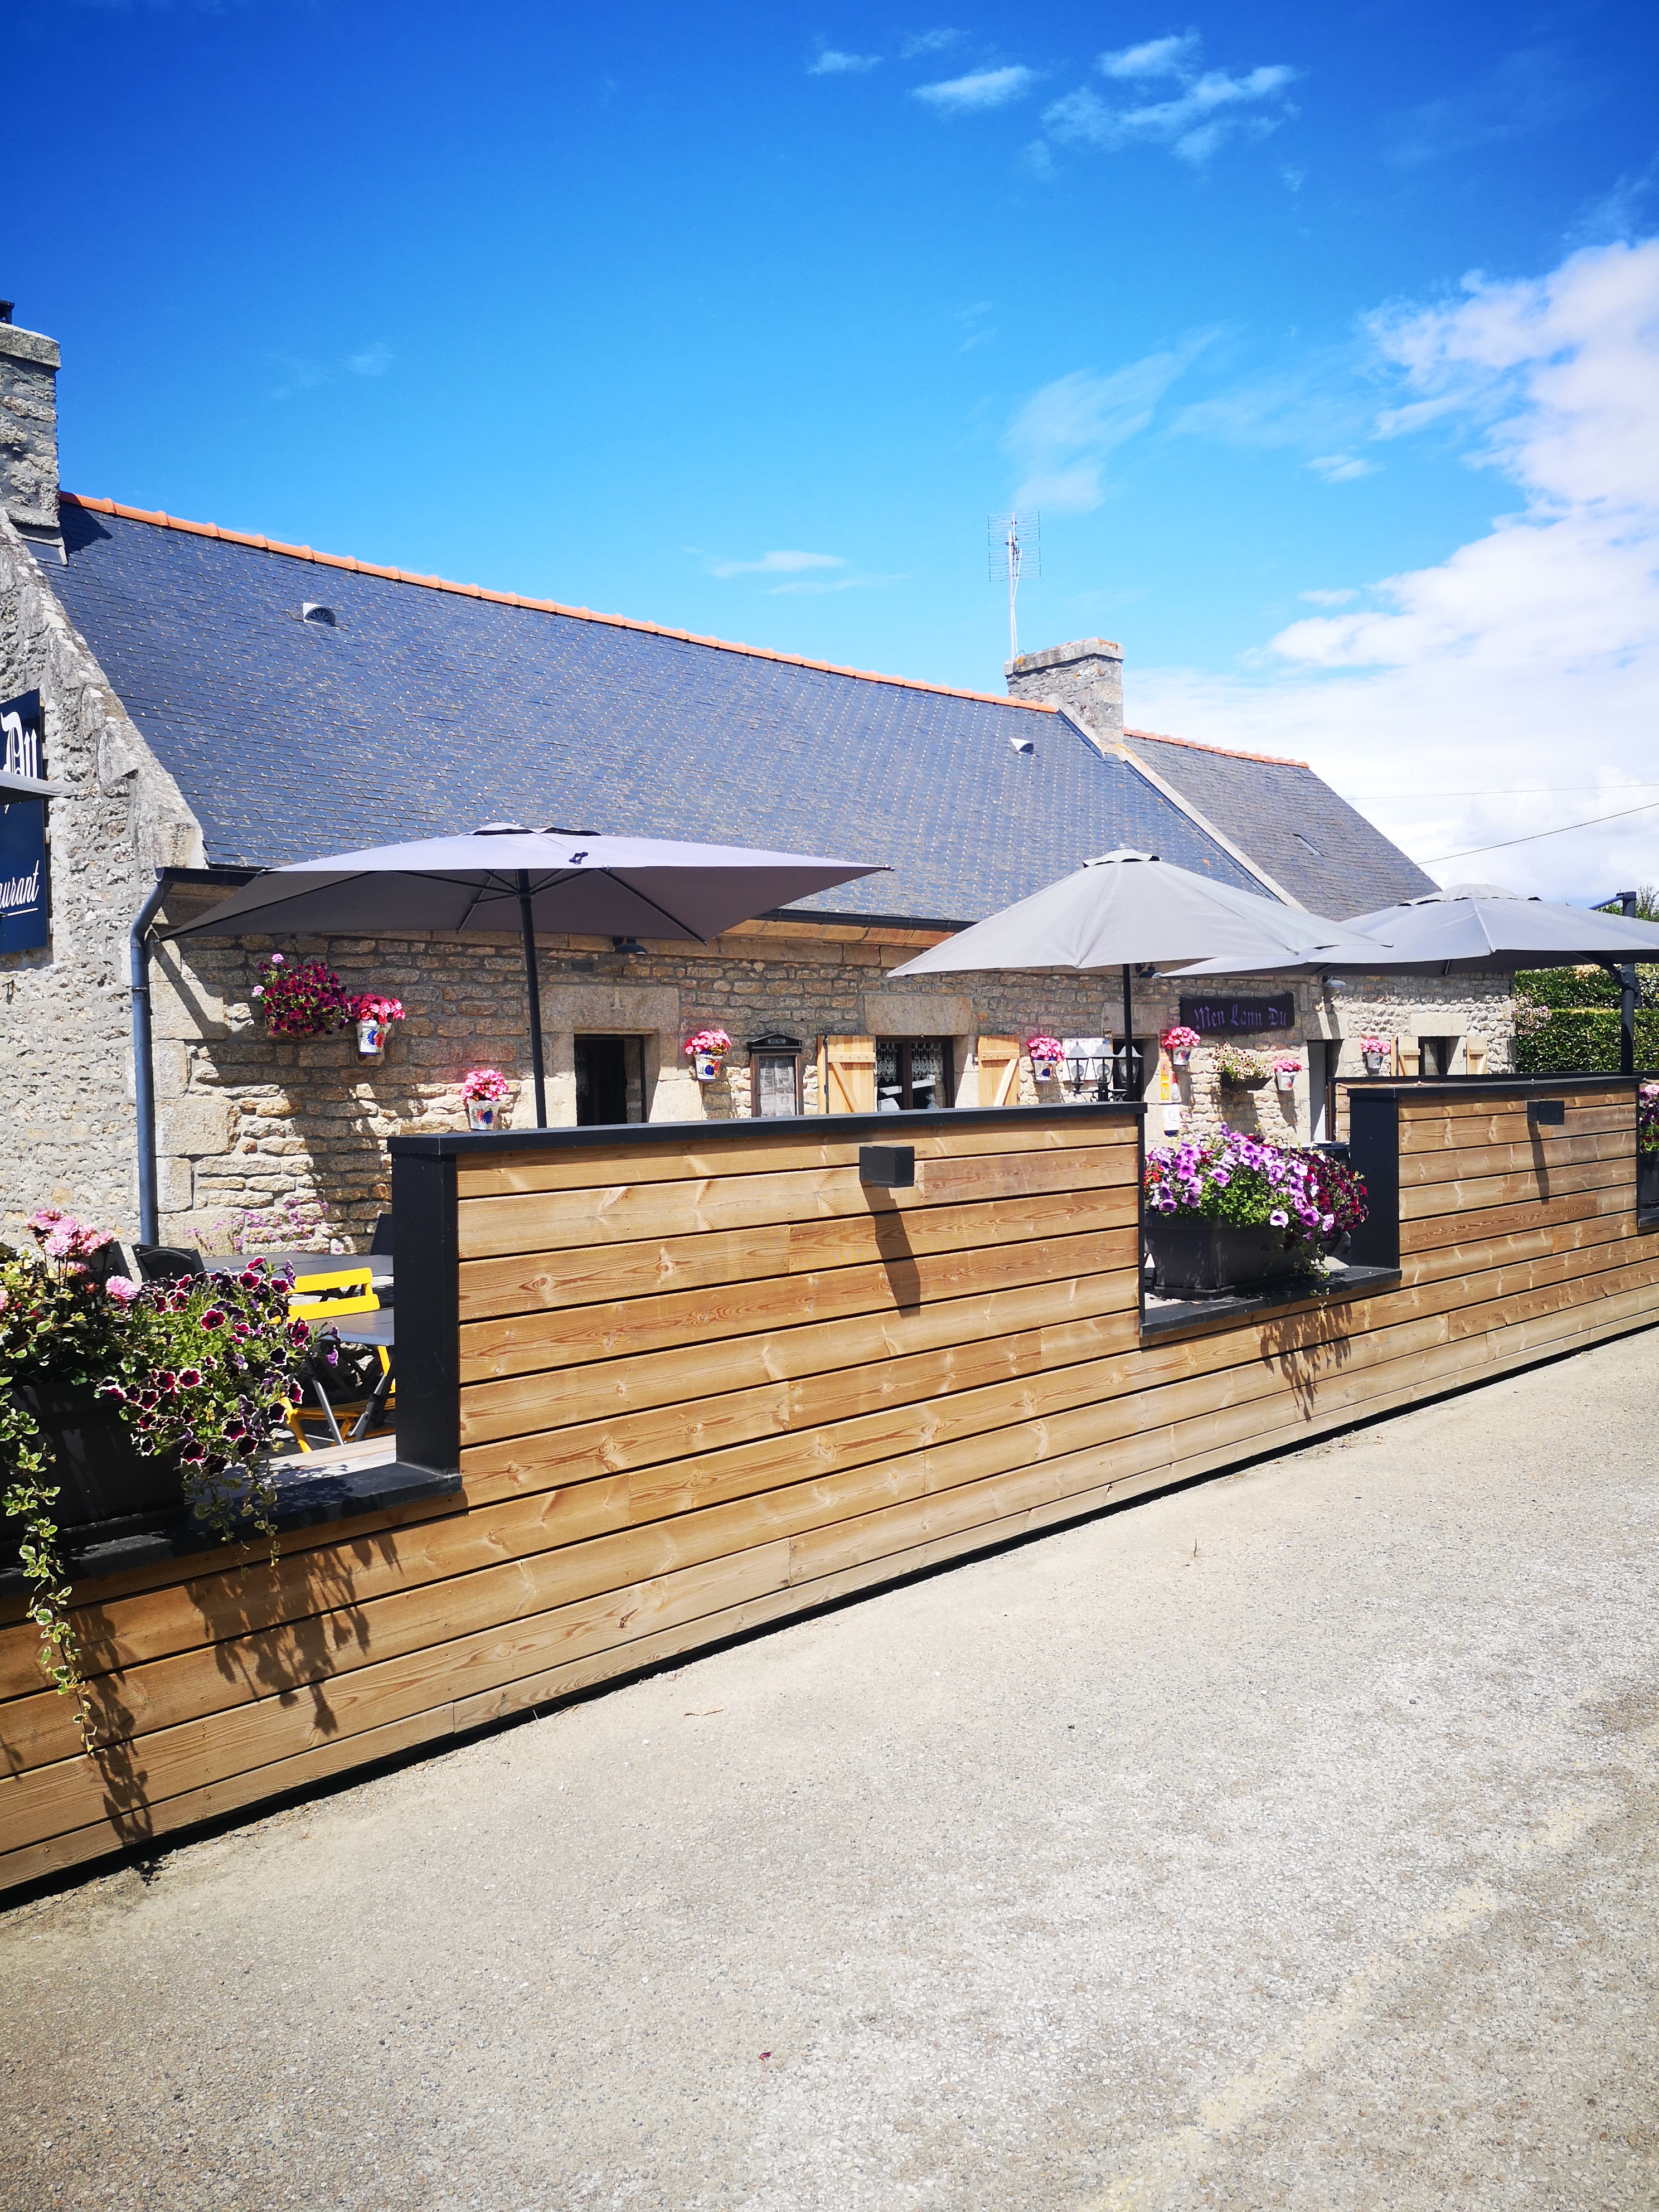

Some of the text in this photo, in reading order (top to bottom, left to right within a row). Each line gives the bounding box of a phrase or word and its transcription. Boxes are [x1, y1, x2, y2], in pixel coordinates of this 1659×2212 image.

[1194, 1003, 1286, 1030] Men Lann Du
